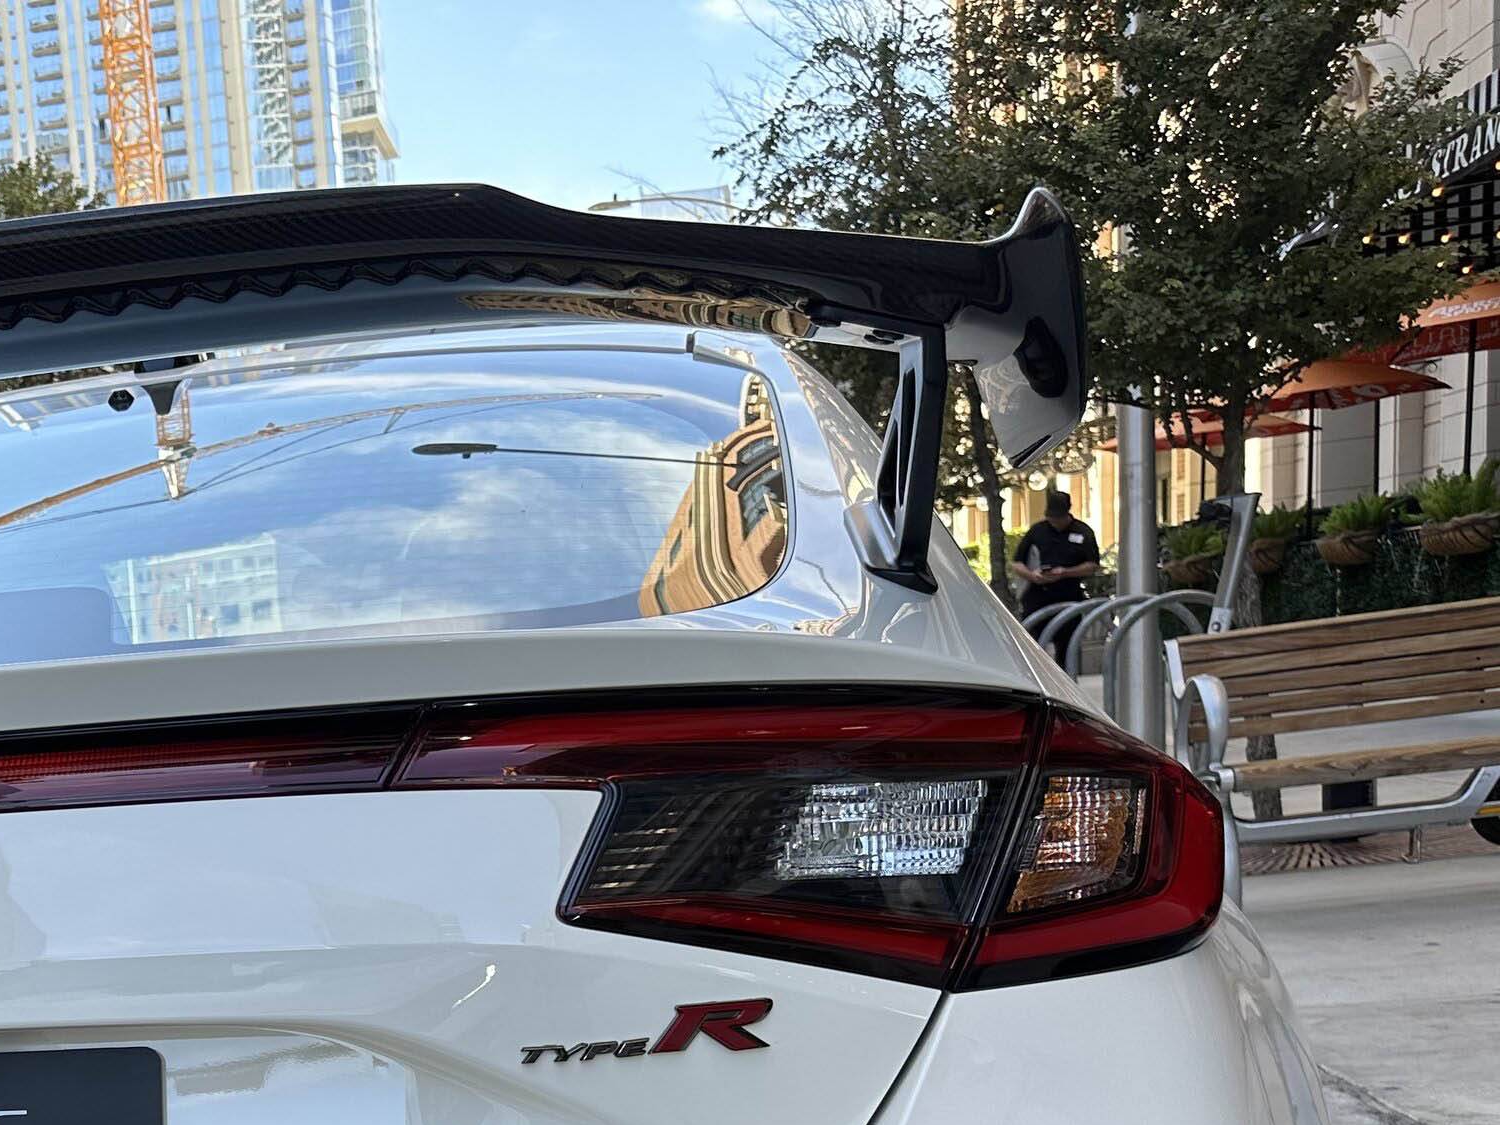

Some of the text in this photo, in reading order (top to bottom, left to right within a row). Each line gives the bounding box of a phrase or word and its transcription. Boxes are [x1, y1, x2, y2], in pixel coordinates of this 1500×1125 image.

[1431, 113, 1500, 179] STRAN
[520, 997, 773, 1064] TYPE R
